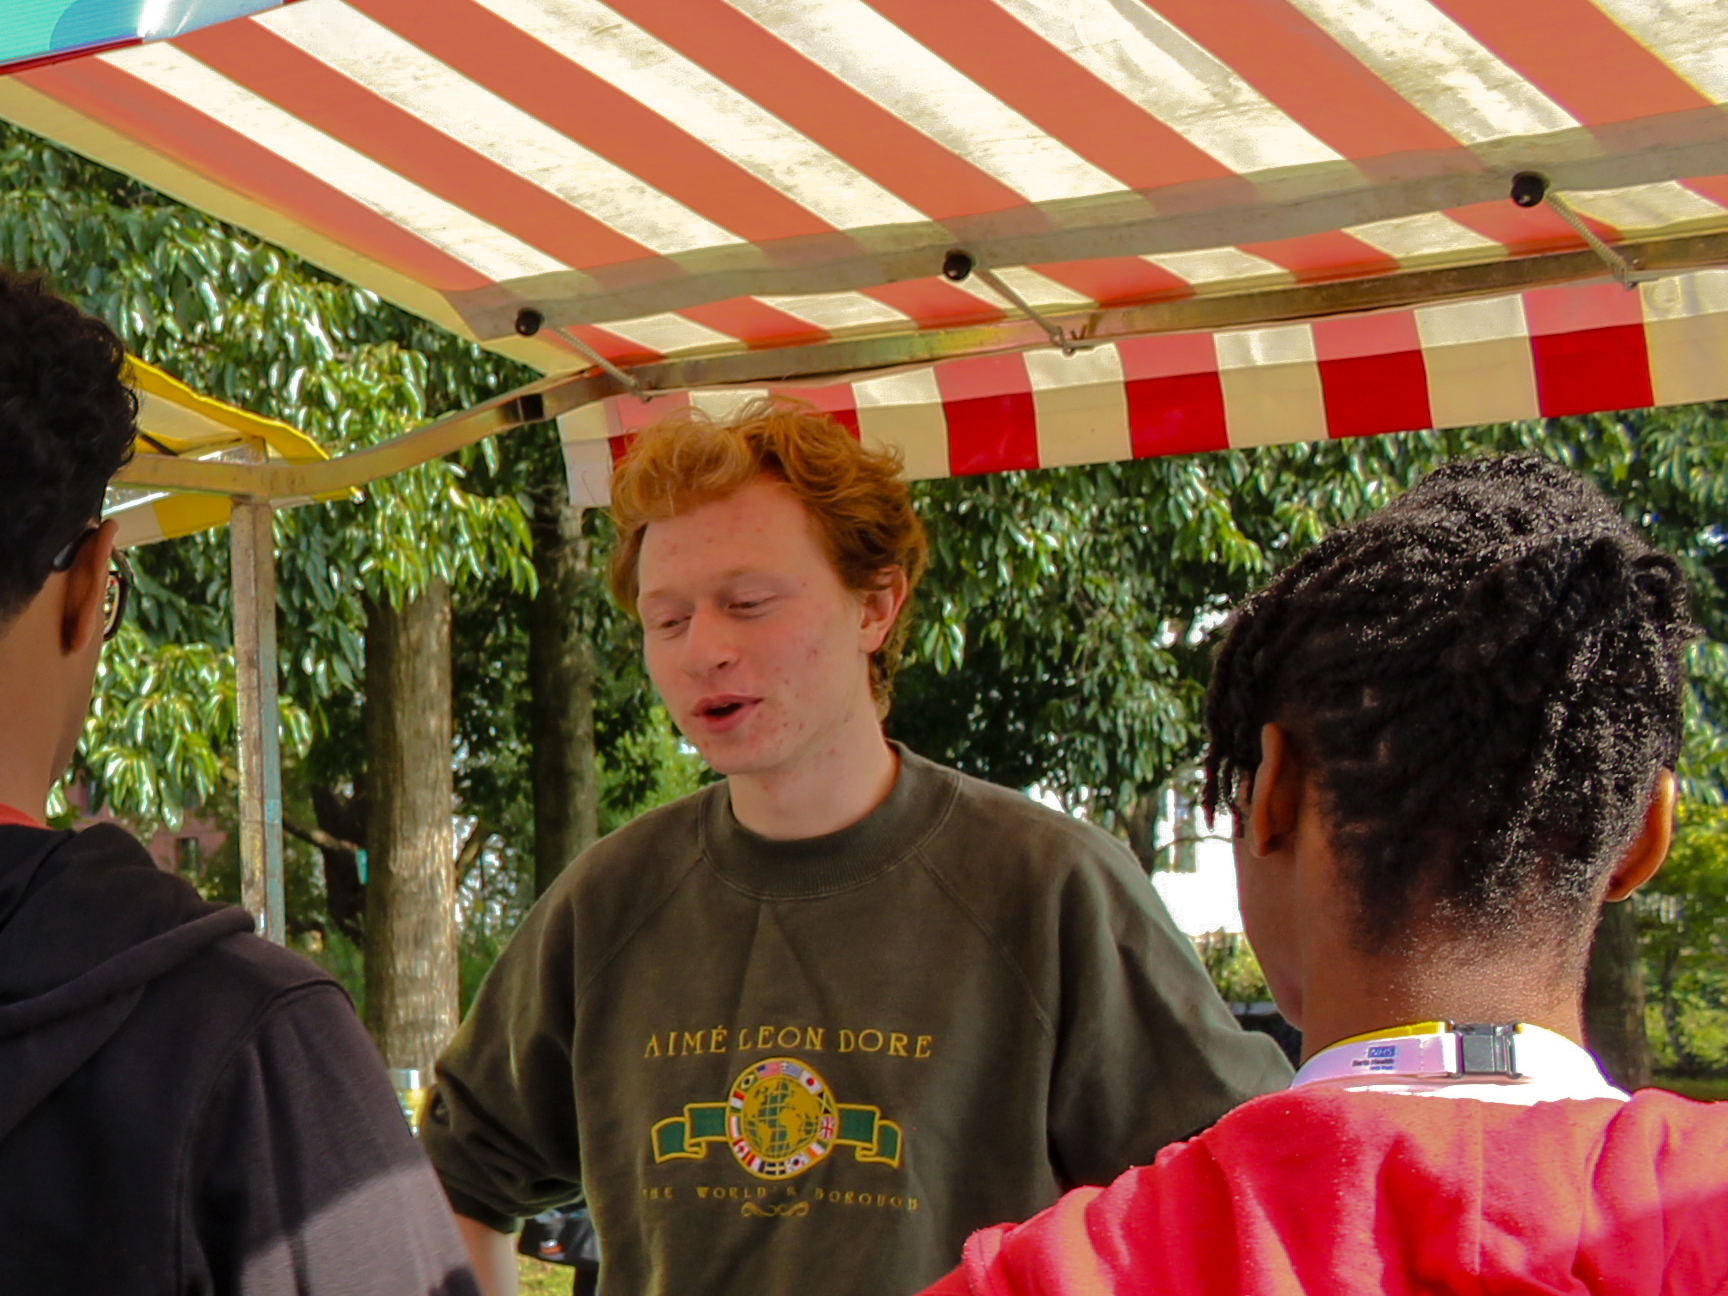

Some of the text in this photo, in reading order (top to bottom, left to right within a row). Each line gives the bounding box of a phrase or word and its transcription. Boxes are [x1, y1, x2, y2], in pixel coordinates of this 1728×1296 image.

[644, 1024, 932, 1058] AIMÉ LEON DORE
[1369, 1047, 1394, 1057] NHS
[814, 1187, 919, 1210] BOROUGH
